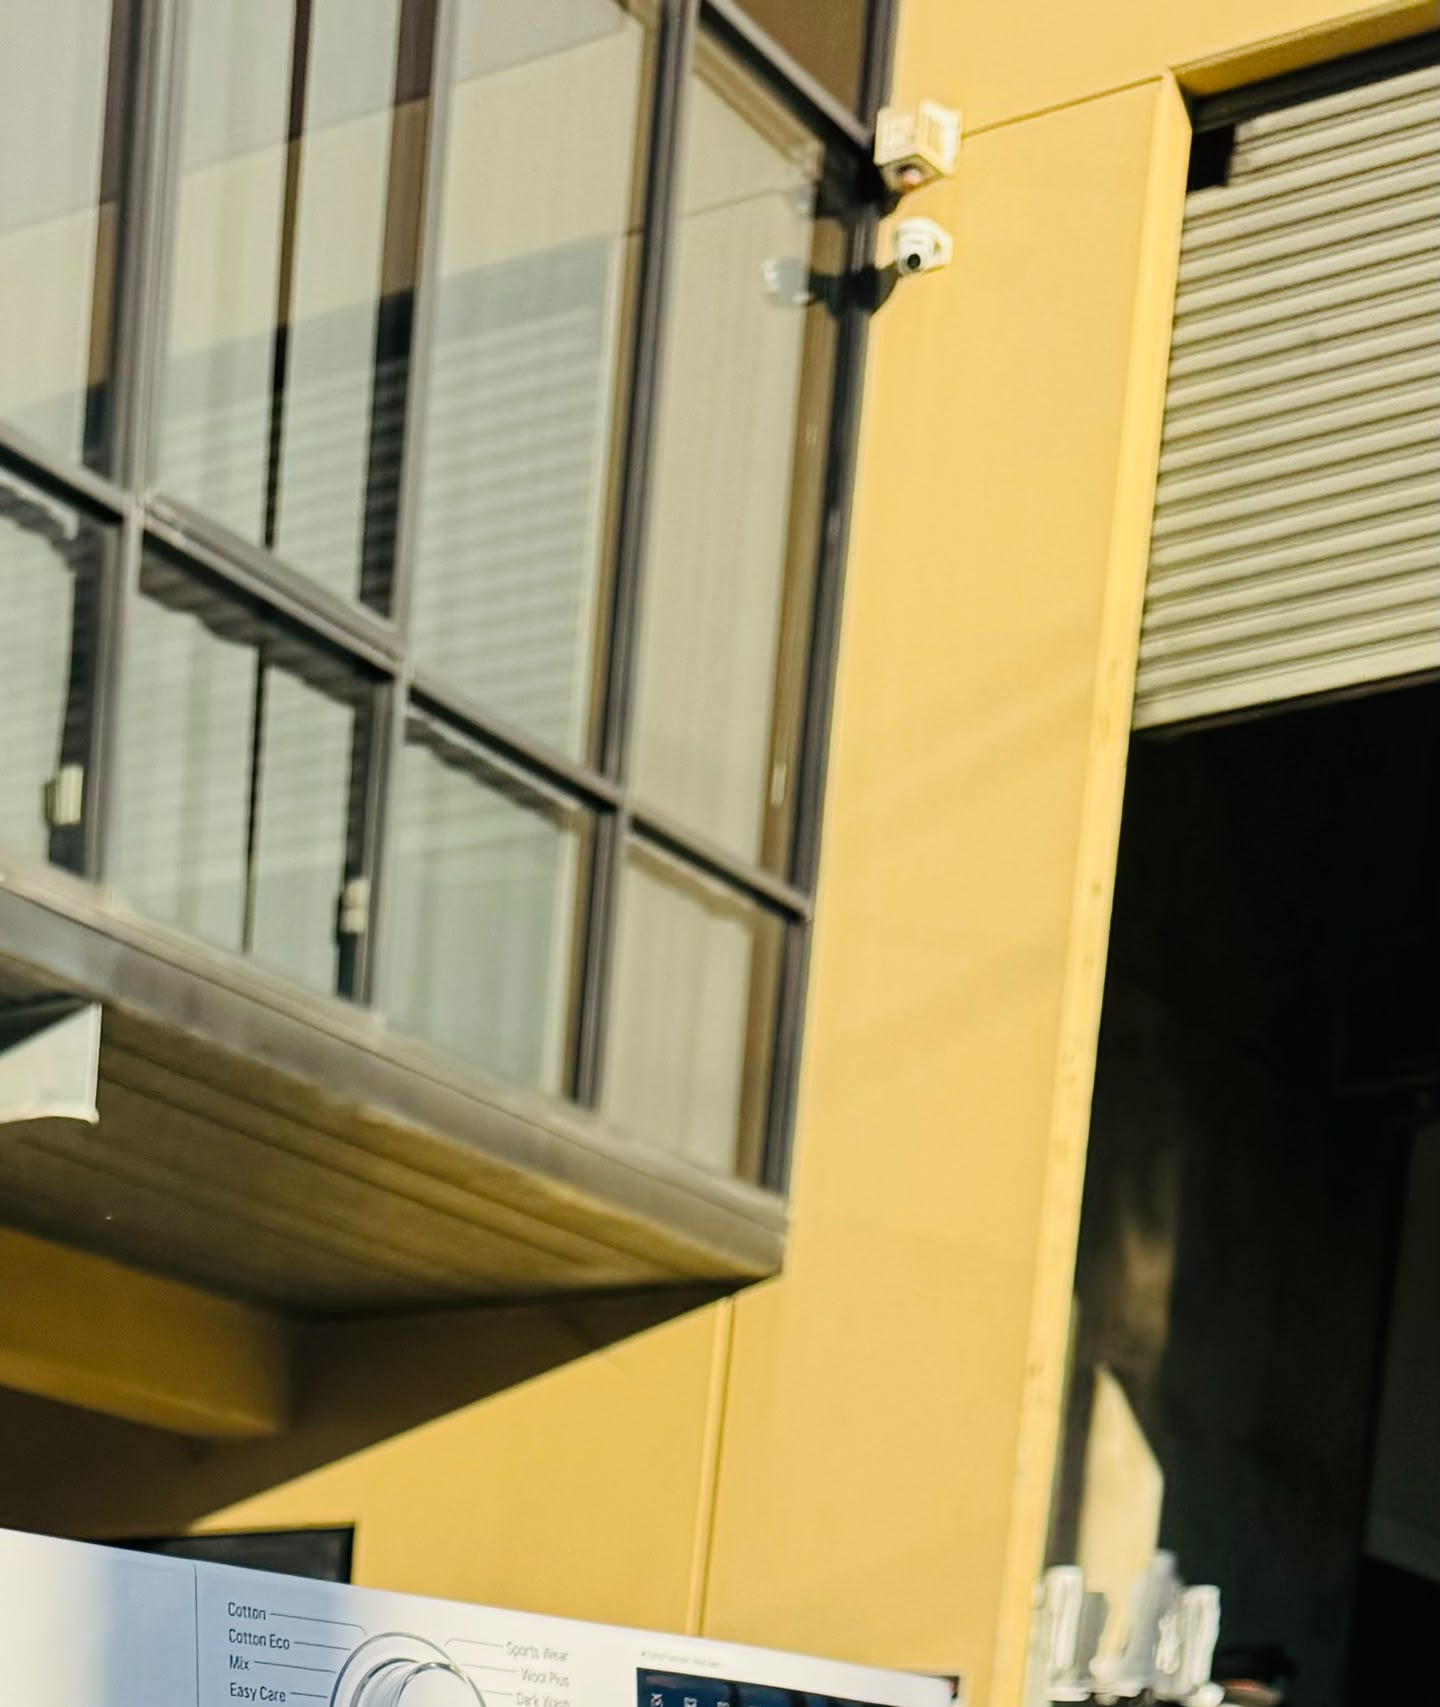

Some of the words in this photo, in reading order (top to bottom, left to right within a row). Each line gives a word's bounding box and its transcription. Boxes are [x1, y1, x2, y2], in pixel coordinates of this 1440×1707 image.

[228, 1602, 266, 1621] Cotton
[228, 1629, 266, 1647] Cotton
[269, 1634, 290, 1650] Eco
[229, 1654, 250, 1671] Mix
[230, 1683, 257, 1701] Easy
[259, 1686, 286, 1703] Care
